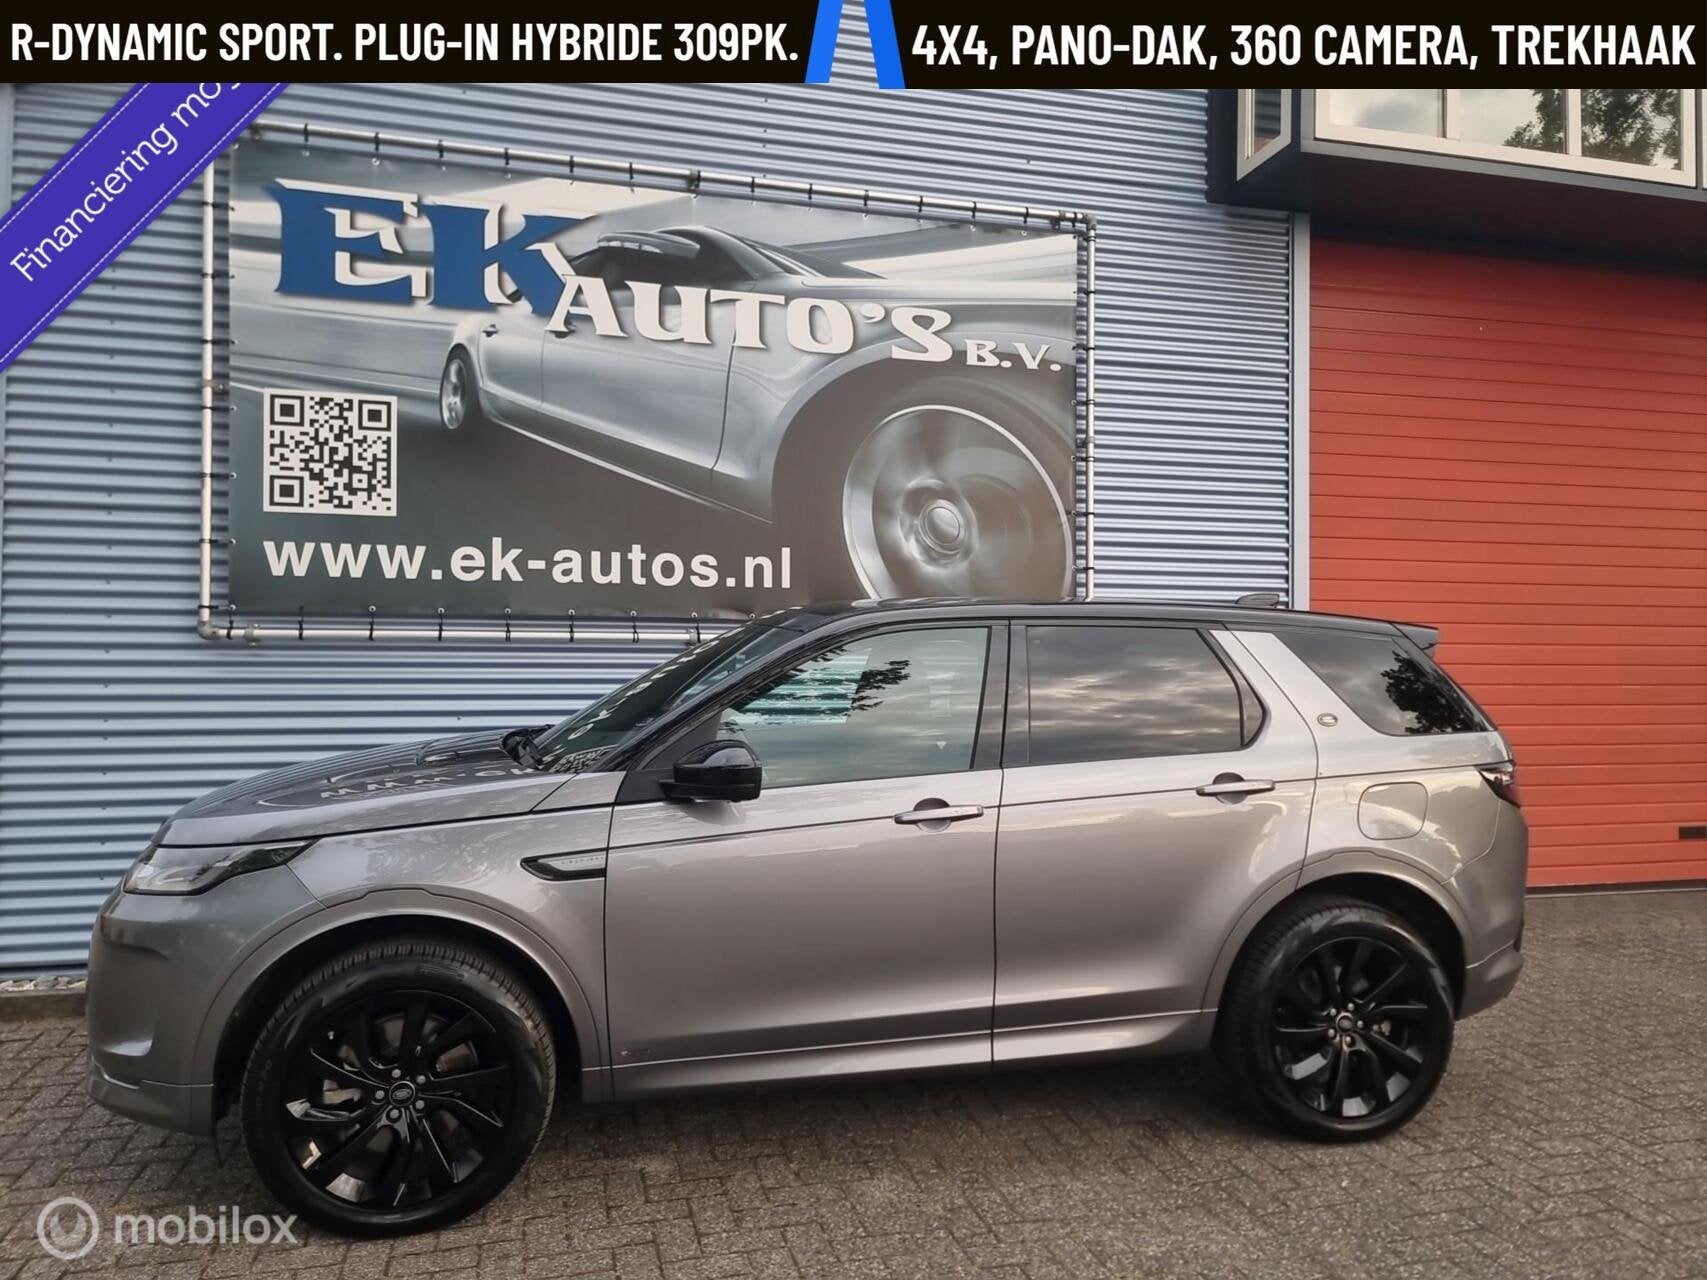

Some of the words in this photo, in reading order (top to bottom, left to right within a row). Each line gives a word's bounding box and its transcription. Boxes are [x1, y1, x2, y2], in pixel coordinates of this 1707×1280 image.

[264, 178, 600, 317] EK
[964, 339, 1062, 371] B.V.
[263, 537, 792, 590] www.ek-autos.nl
